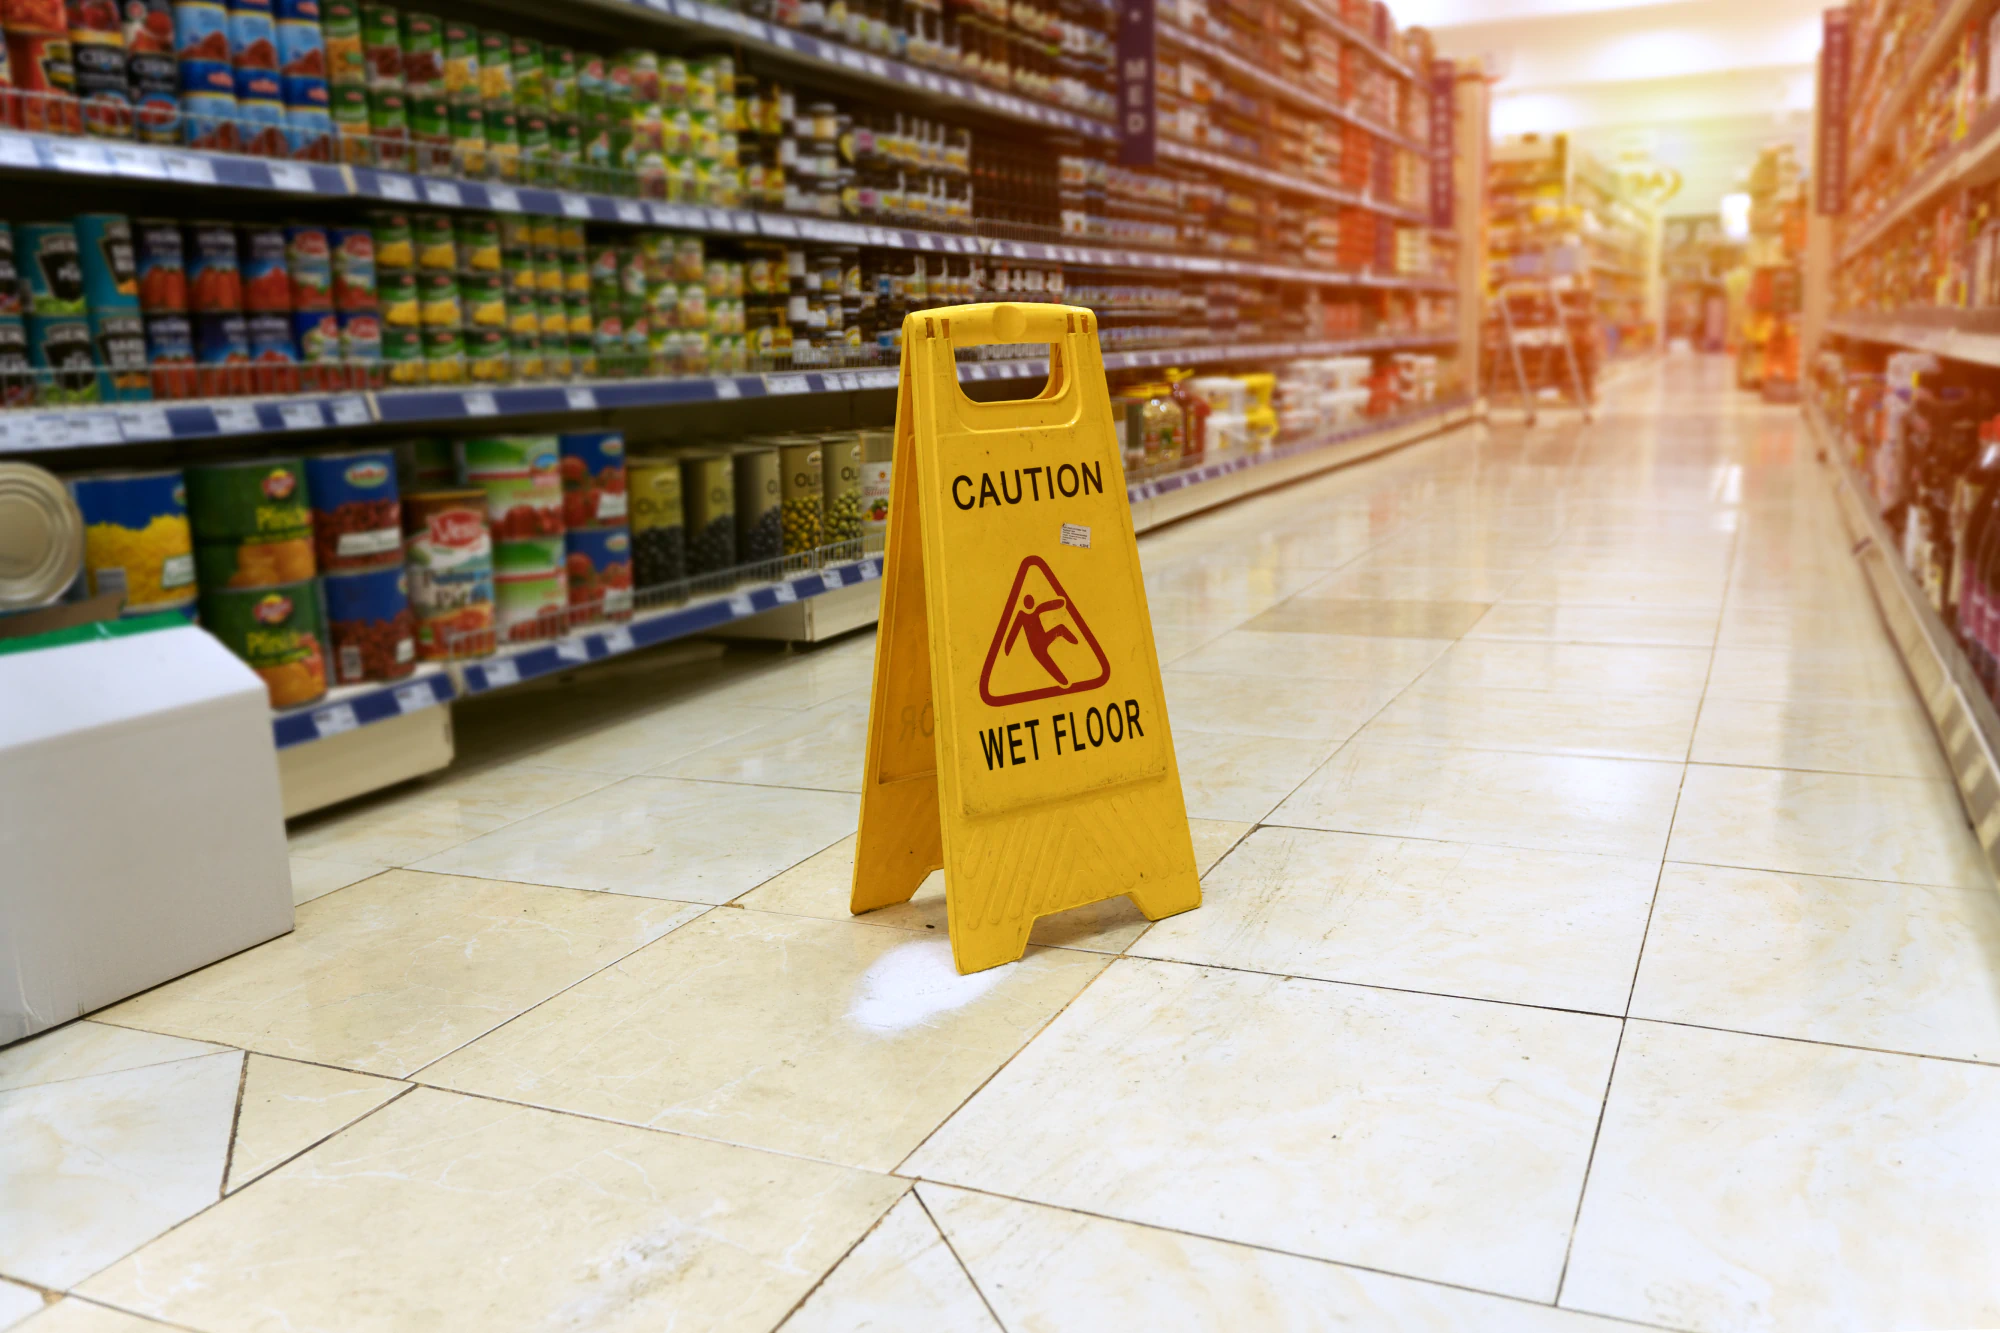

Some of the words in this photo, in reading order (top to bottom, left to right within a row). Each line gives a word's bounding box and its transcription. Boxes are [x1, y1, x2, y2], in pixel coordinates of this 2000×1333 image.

[953, 461, 1103, 511] CAUTION
[978, 720, 1040, 771] WET
[1052, 699, 1145, 756] FLOOR
